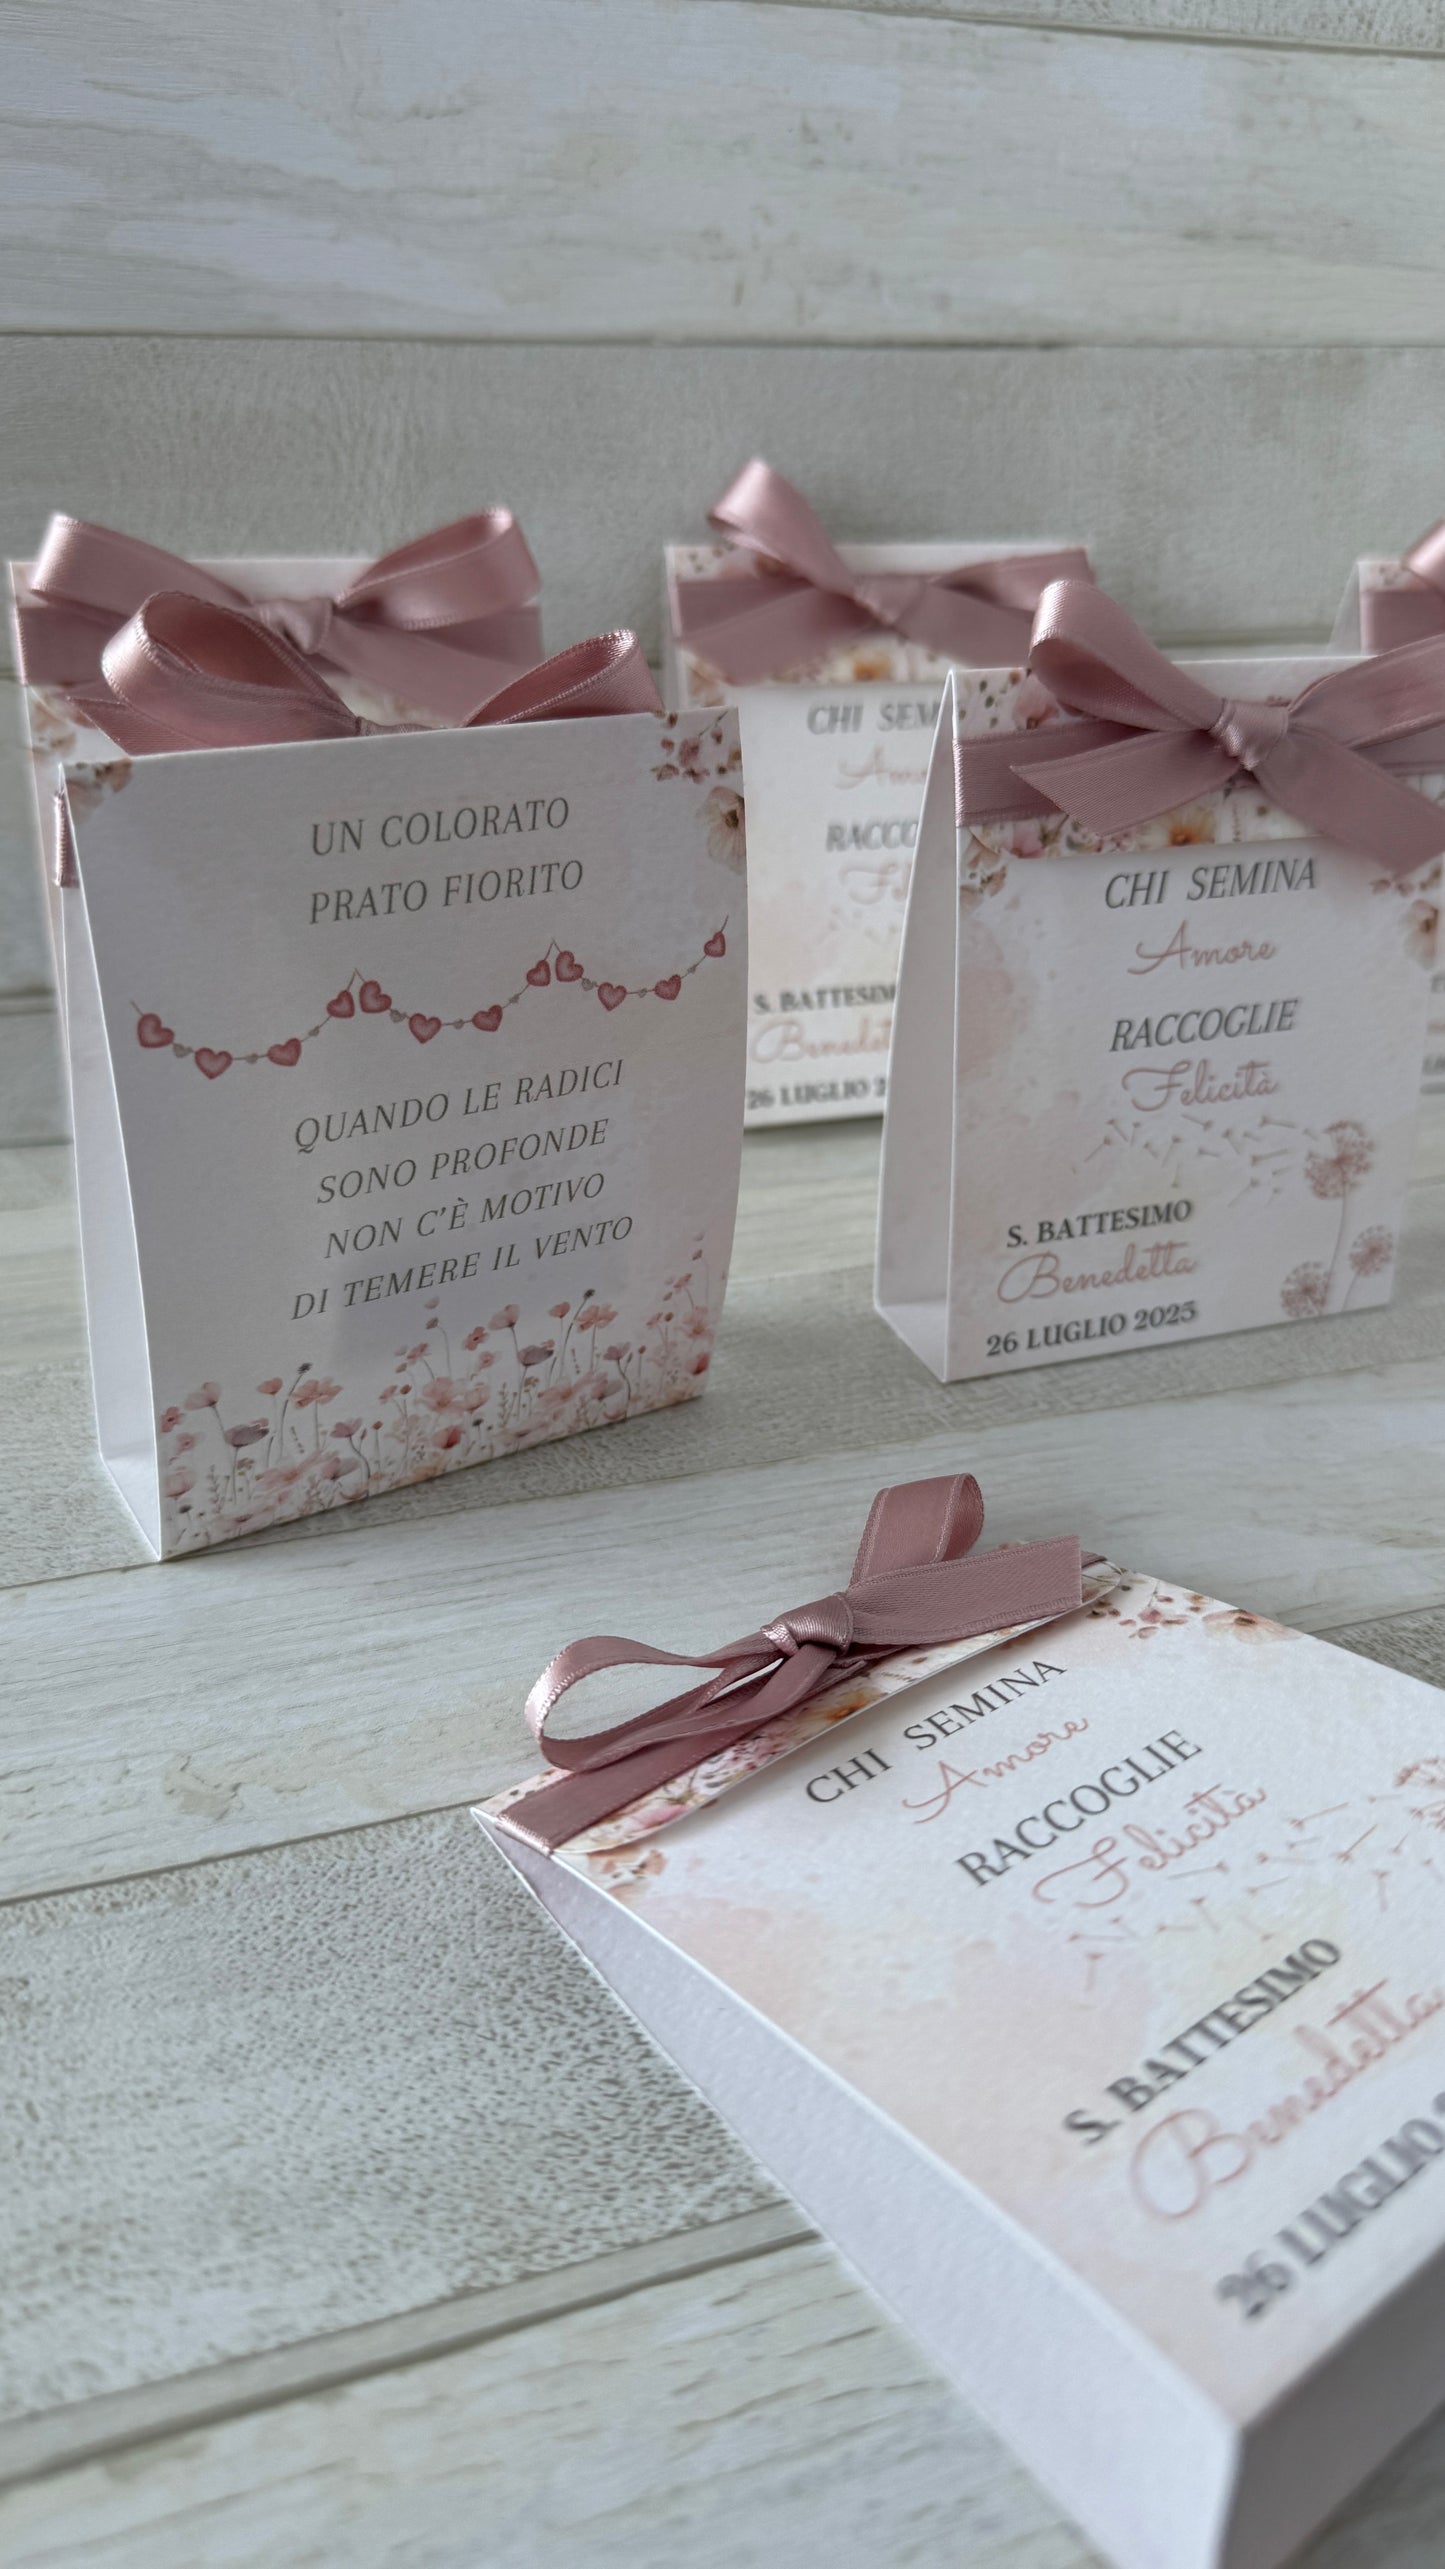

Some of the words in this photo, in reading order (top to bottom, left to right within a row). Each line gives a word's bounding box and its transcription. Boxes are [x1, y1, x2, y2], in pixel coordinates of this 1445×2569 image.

[807, 704, 864, 735] CHI
[876, 702, 940, 732] SEM
[312, 818, 366, 856] UN
[381, 797, 569, 847] COLORATO
[309, 880, 427, 924] PRATO
[442, 860, 583, 906] FIORITO
[1105, 869, 1170, 909] CHI
[1187, 857, 1316, 901] SEMINA
[1127, 919, 1276, 975] Amore
[779, 984, 896, 1013] BATTESIM
[1109, 998, 1300, 1052] RACCOGLIE
[295, 1093, 449, 1154] QUANDO
[463, 1082, 501, 1115] LE
[514, 1059, 624, 1105] RADICI
[1121, 1059, 1279, 1112] Felicità
[317, 1159, 416, 1204] SONO
[430, 1118, 609, 1181] PROFONDE
[324, 1218, 404, 1259] NON
[480, 1173, 605, 1224] MOTIVO
[1006, 1225, 1028, 1249] S.
[1036, 1199, 1192, 1244] BATTESIMO
[290, 1289, 328, 1320] DI
[343, 1252, 480, 1307] TEMERE
[492, 1243, 520, 1271] IL
[535, 1216, 633, 1260] VENTO
[997, 1241, 1199, 1303] Benedetta
[986, 1331, 1018, 1357] 26
[1027, 1312, 1126, 1349] LUGLIO
[1134, 1300, 1197, 1331] 2025
[806, 1748, 894, 1803] CHI
[903, 1660, 1067, 1751] SEMINA
[902, 1717, 1089, 1825] Amore
[954, 1729, 1203, 1887] RACCOGLIE
[1032, 1783, 1267, 1908] Felicità
[1063, 2108, 1124, 2147] S.
[1105, 1938, 1341, 2113] BATTESIMO
[1129, 1978, 1445, 2223] Benedetta
[1214, 2248, 1294, 2319] 26
[1273, 2118, 1445, 2267] LUGLIO
